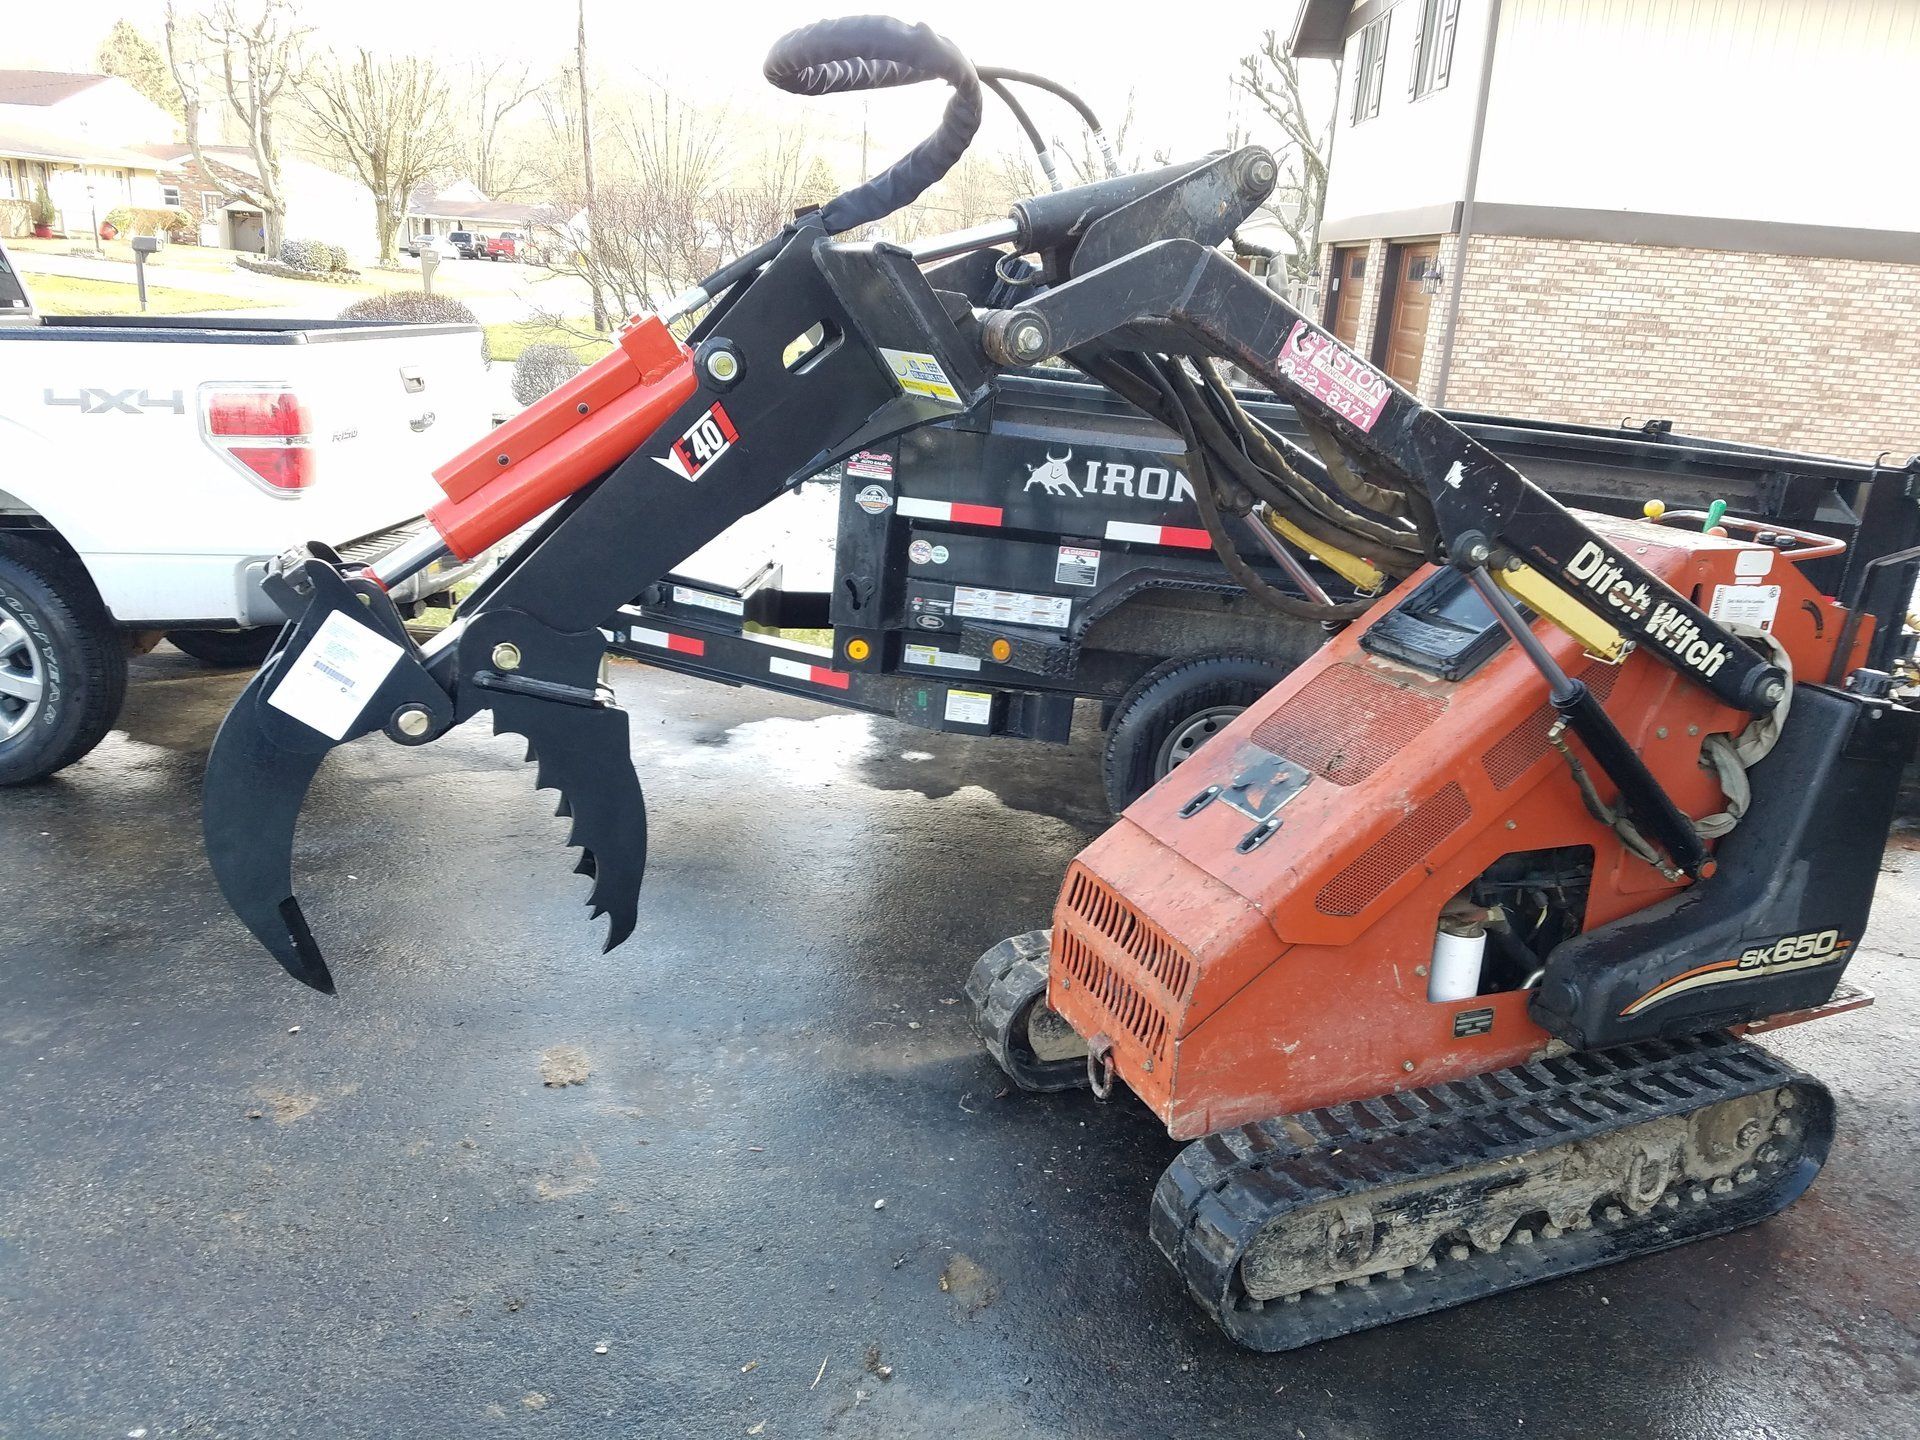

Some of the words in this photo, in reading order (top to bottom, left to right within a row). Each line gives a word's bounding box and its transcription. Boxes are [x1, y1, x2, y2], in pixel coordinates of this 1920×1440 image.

[1291, 322, 1392, 400] GASTON
[1307, 364, 1318, 376] 321
[1319, 361, 1344, 384] FENCE
[1083, 460, 1197, 502] IRON
[1566, 540, 1651, 620] Ditch
[1739, 929, 1839, 968] SK650
